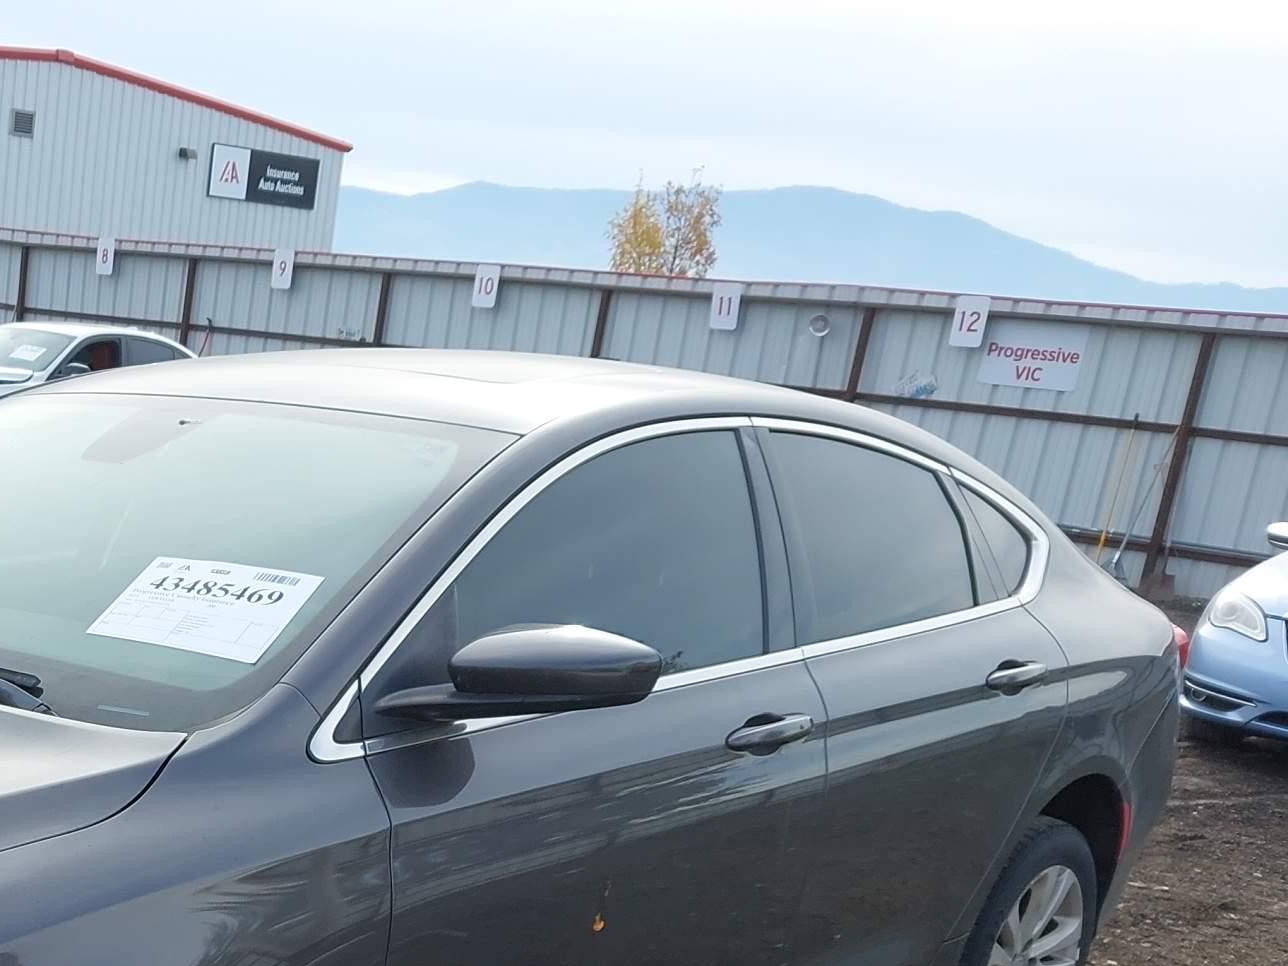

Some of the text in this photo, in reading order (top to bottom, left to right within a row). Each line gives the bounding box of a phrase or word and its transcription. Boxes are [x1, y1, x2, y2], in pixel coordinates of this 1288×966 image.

[266, 164, 300, 181] Insurance
[258, 177, 304, 196] Auto Auctions
[101, 248, 109, 265] 8
[278, 260, 287, 277] 9
[478, 275, 494, 295] 10
[717, 295, 732, 316] 11
[958, 311, 981, 332] 12
[987, 342, 1080, 364] Progressive
[1015, 365, 1043, 382] VIC
[150, 575, 284, 606] 43485469
